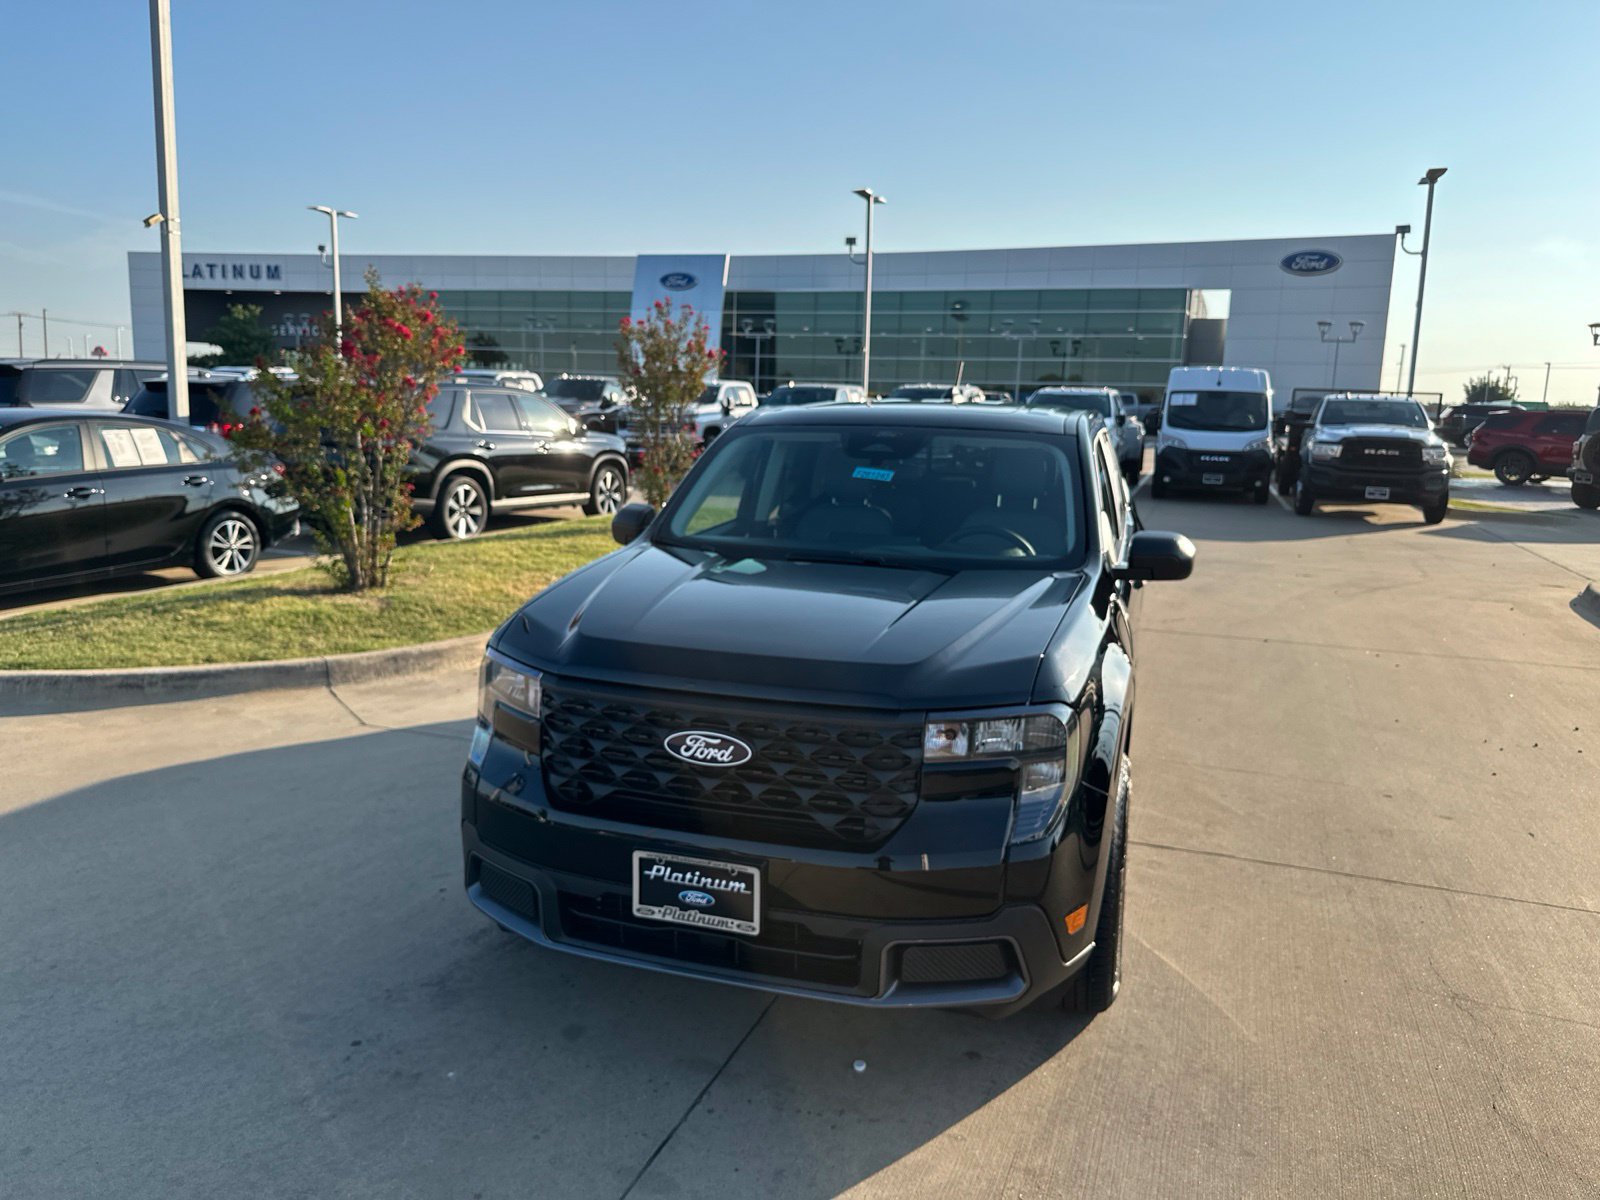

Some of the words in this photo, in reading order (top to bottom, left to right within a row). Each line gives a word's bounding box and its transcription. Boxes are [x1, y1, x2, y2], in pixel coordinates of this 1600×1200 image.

[1291, 254, 1328, 270] Ford
[183, 263, 280, 280] LATINUM
[271, 323, 320, 337] SERVIC
[680, 734, 735, 763] Ford
[643, 864, 752, 895] Platinum
[685, 893, 708, 904] Ford
[661, 906, 731, 929] Platinum
